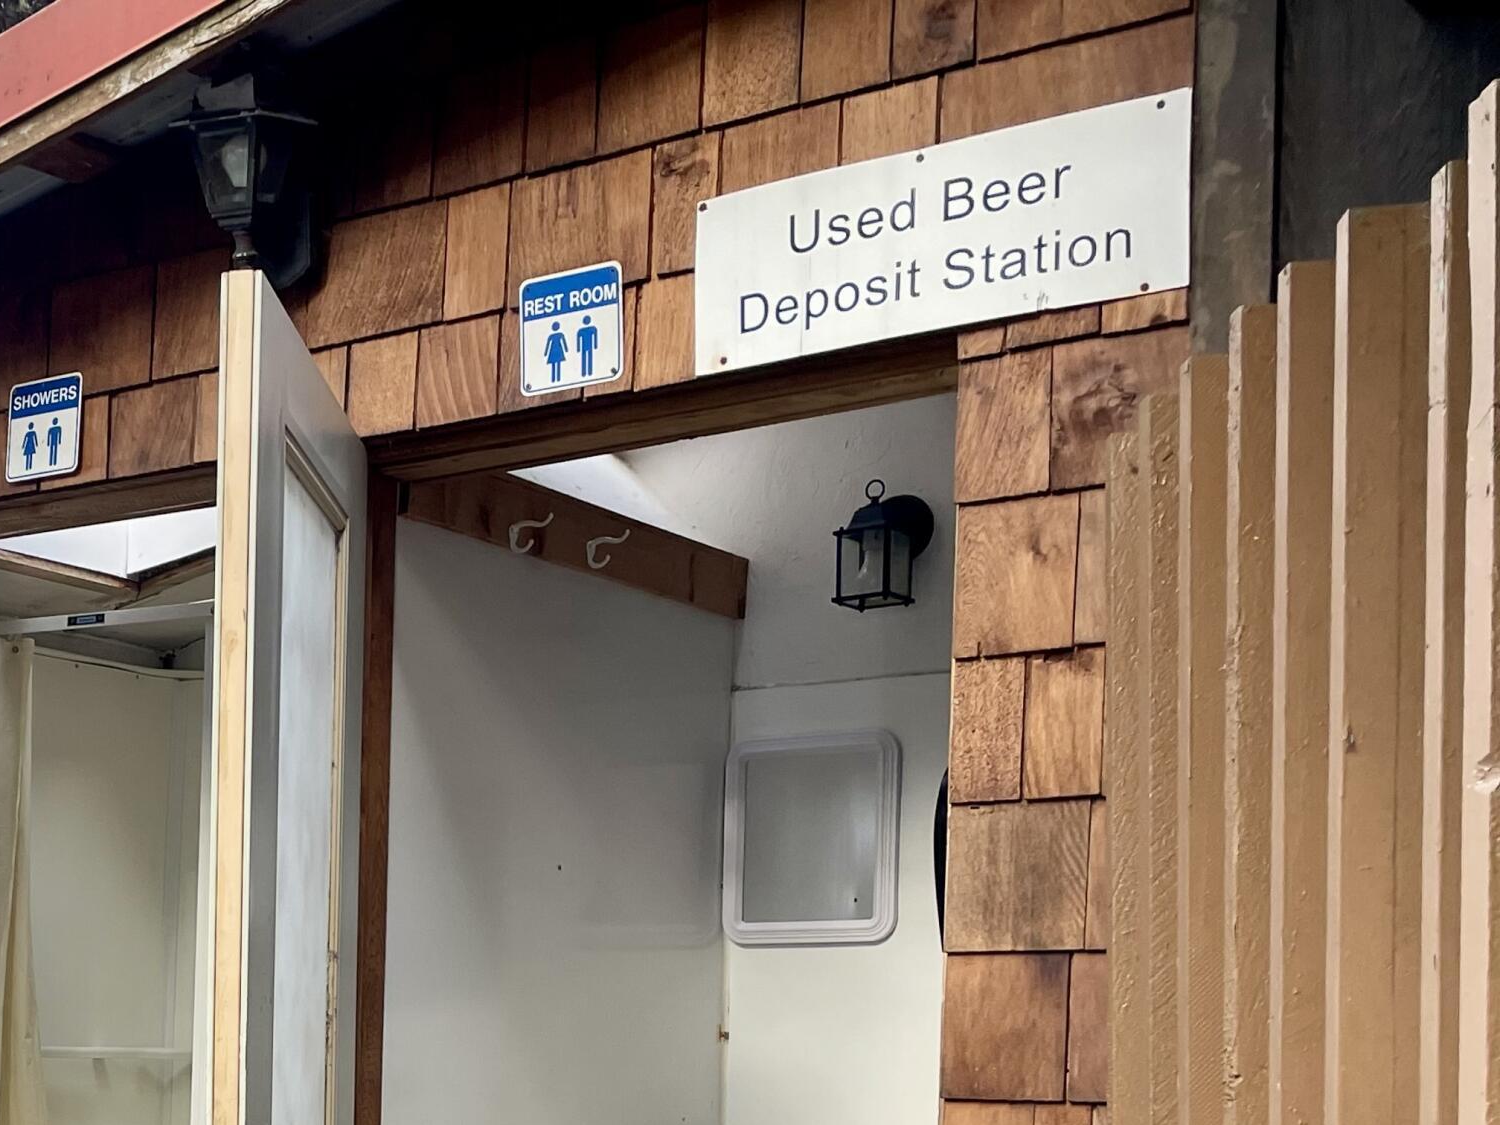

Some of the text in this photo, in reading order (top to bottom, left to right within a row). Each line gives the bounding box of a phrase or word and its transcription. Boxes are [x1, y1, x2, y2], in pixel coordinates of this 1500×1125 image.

[789, 164, 1072, 253] Used Beer
[524, 282, 617, 317] REST ROOM
[739, 227, 1132, 334] Deposit Station
[13, 385, 77, 411] SHOWERS
